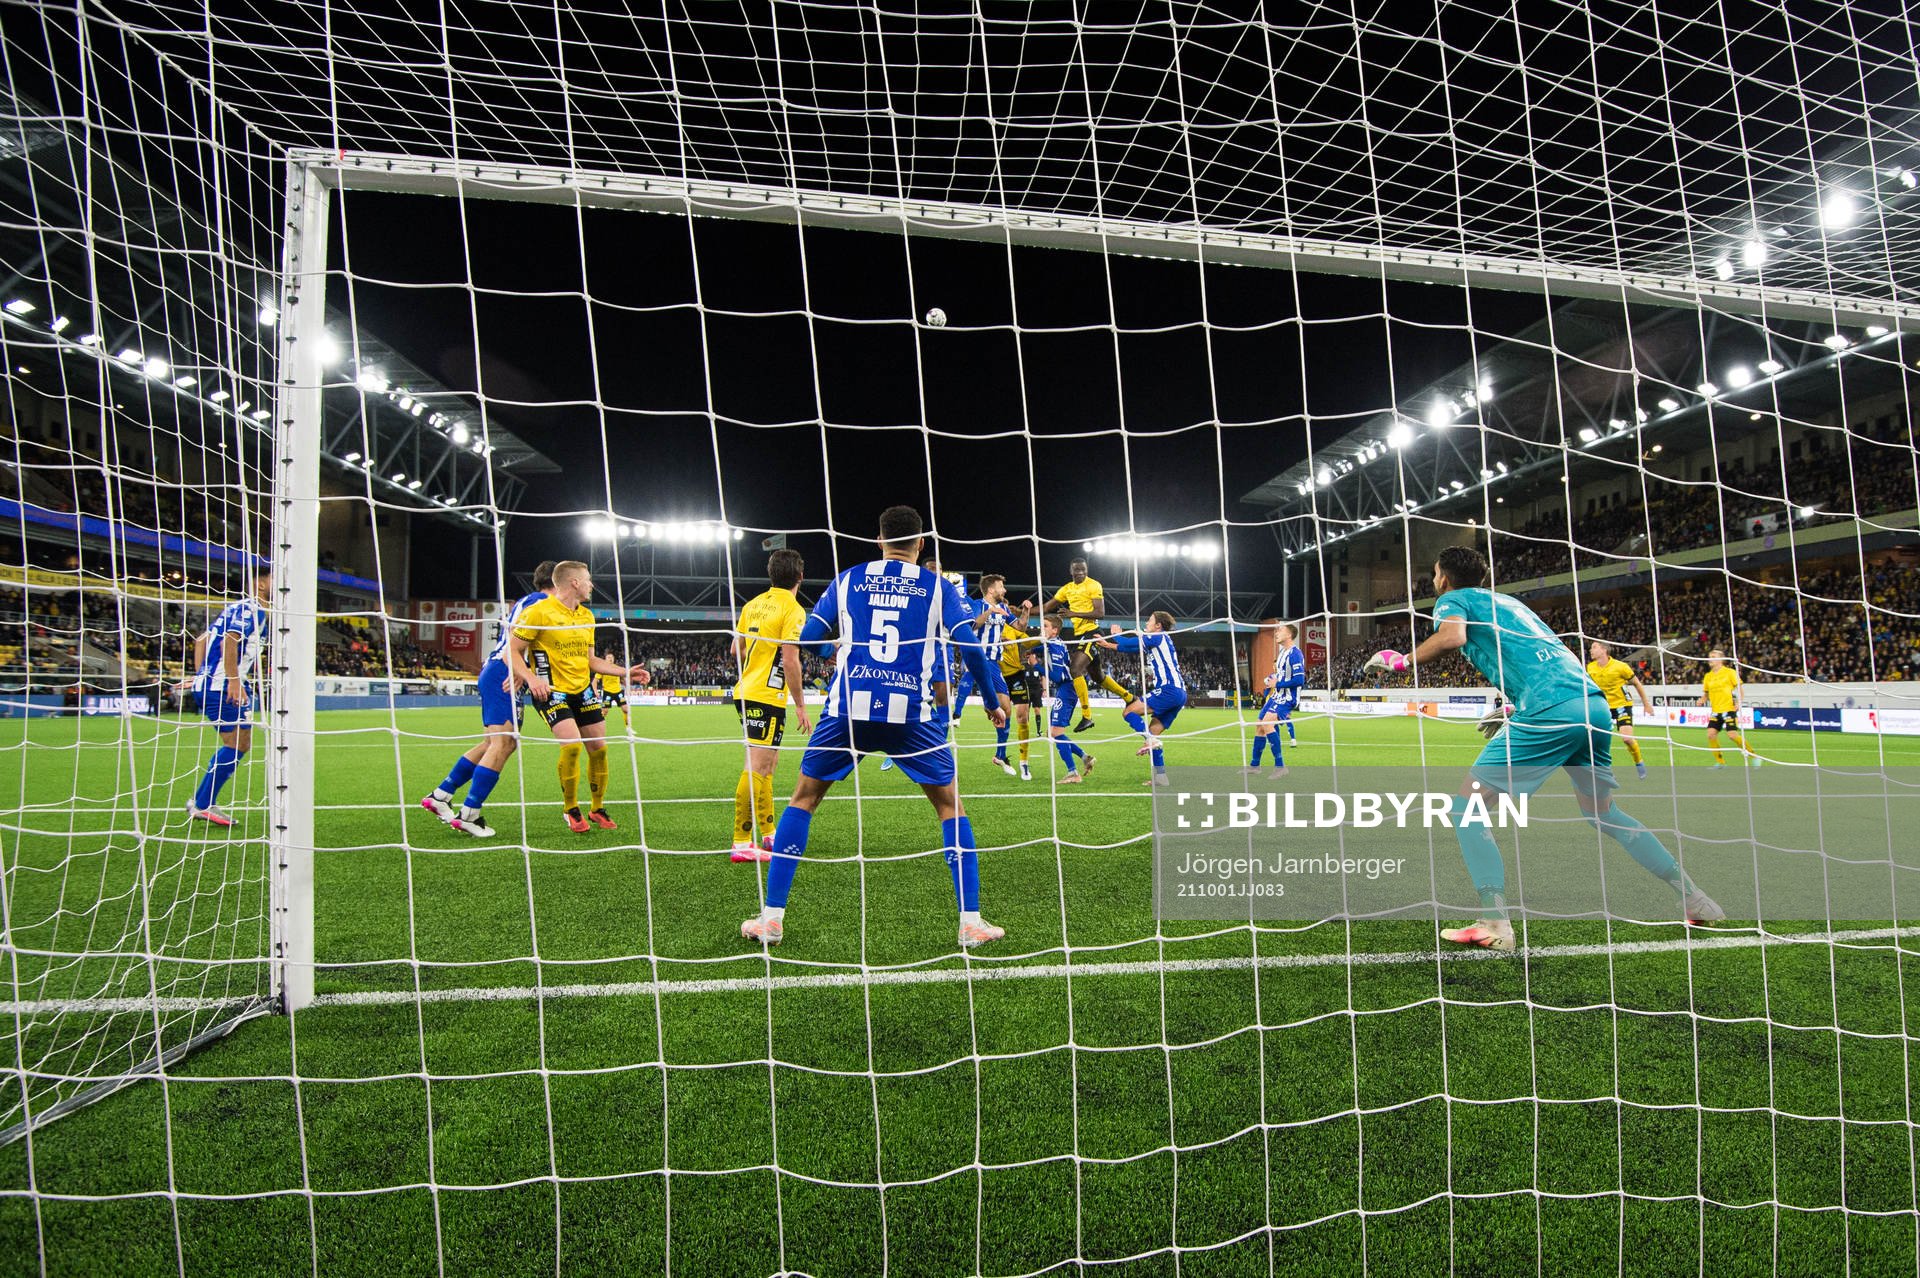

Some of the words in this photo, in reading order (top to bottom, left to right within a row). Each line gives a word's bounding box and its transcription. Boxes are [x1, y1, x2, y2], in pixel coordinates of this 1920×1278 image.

[865, 576, 915, 586] NORDIC
[853, 584, 927, 597] WELLNESS
[868, 593, 909, 609] JALLOW
[450, 636, 470, 644] 7-23
[869, 609, 900, 664] 5
